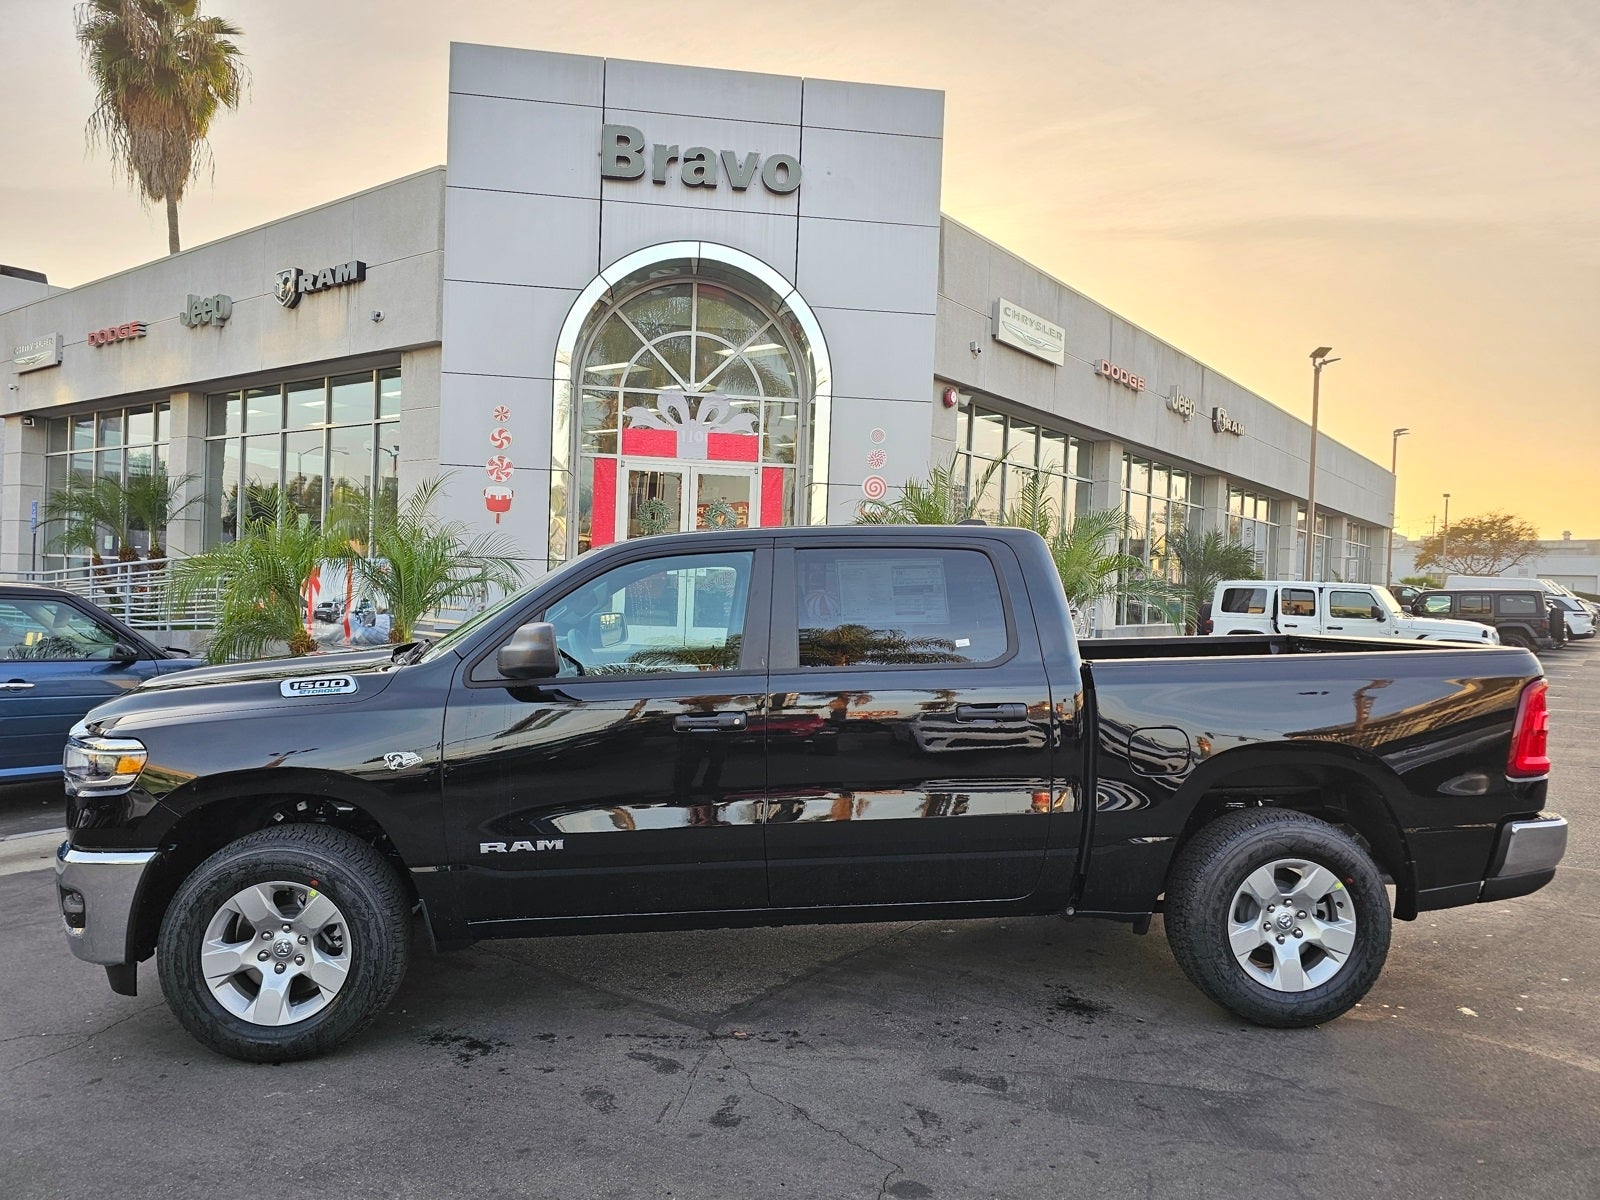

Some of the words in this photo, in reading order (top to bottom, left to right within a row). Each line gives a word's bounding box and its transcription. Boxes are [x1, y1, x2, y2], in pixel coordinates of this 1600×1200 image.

[601, 123, 801, 195] Bravo
[298, 260, 366, 295] RAM
[180, 293, 232, 327] Jeep
[1003, 306, 1063, 341] CHRYSLER
[88, 321, 145, 347] DODGE
[1100, 359, 1145, 392] DODGE
[1171, 385, 1196, 421] Jeep
[1226, 417, 1245, 436] RAM
[293, 679, 346, 690] 1500
[480, 839, 564, 854] RAM
